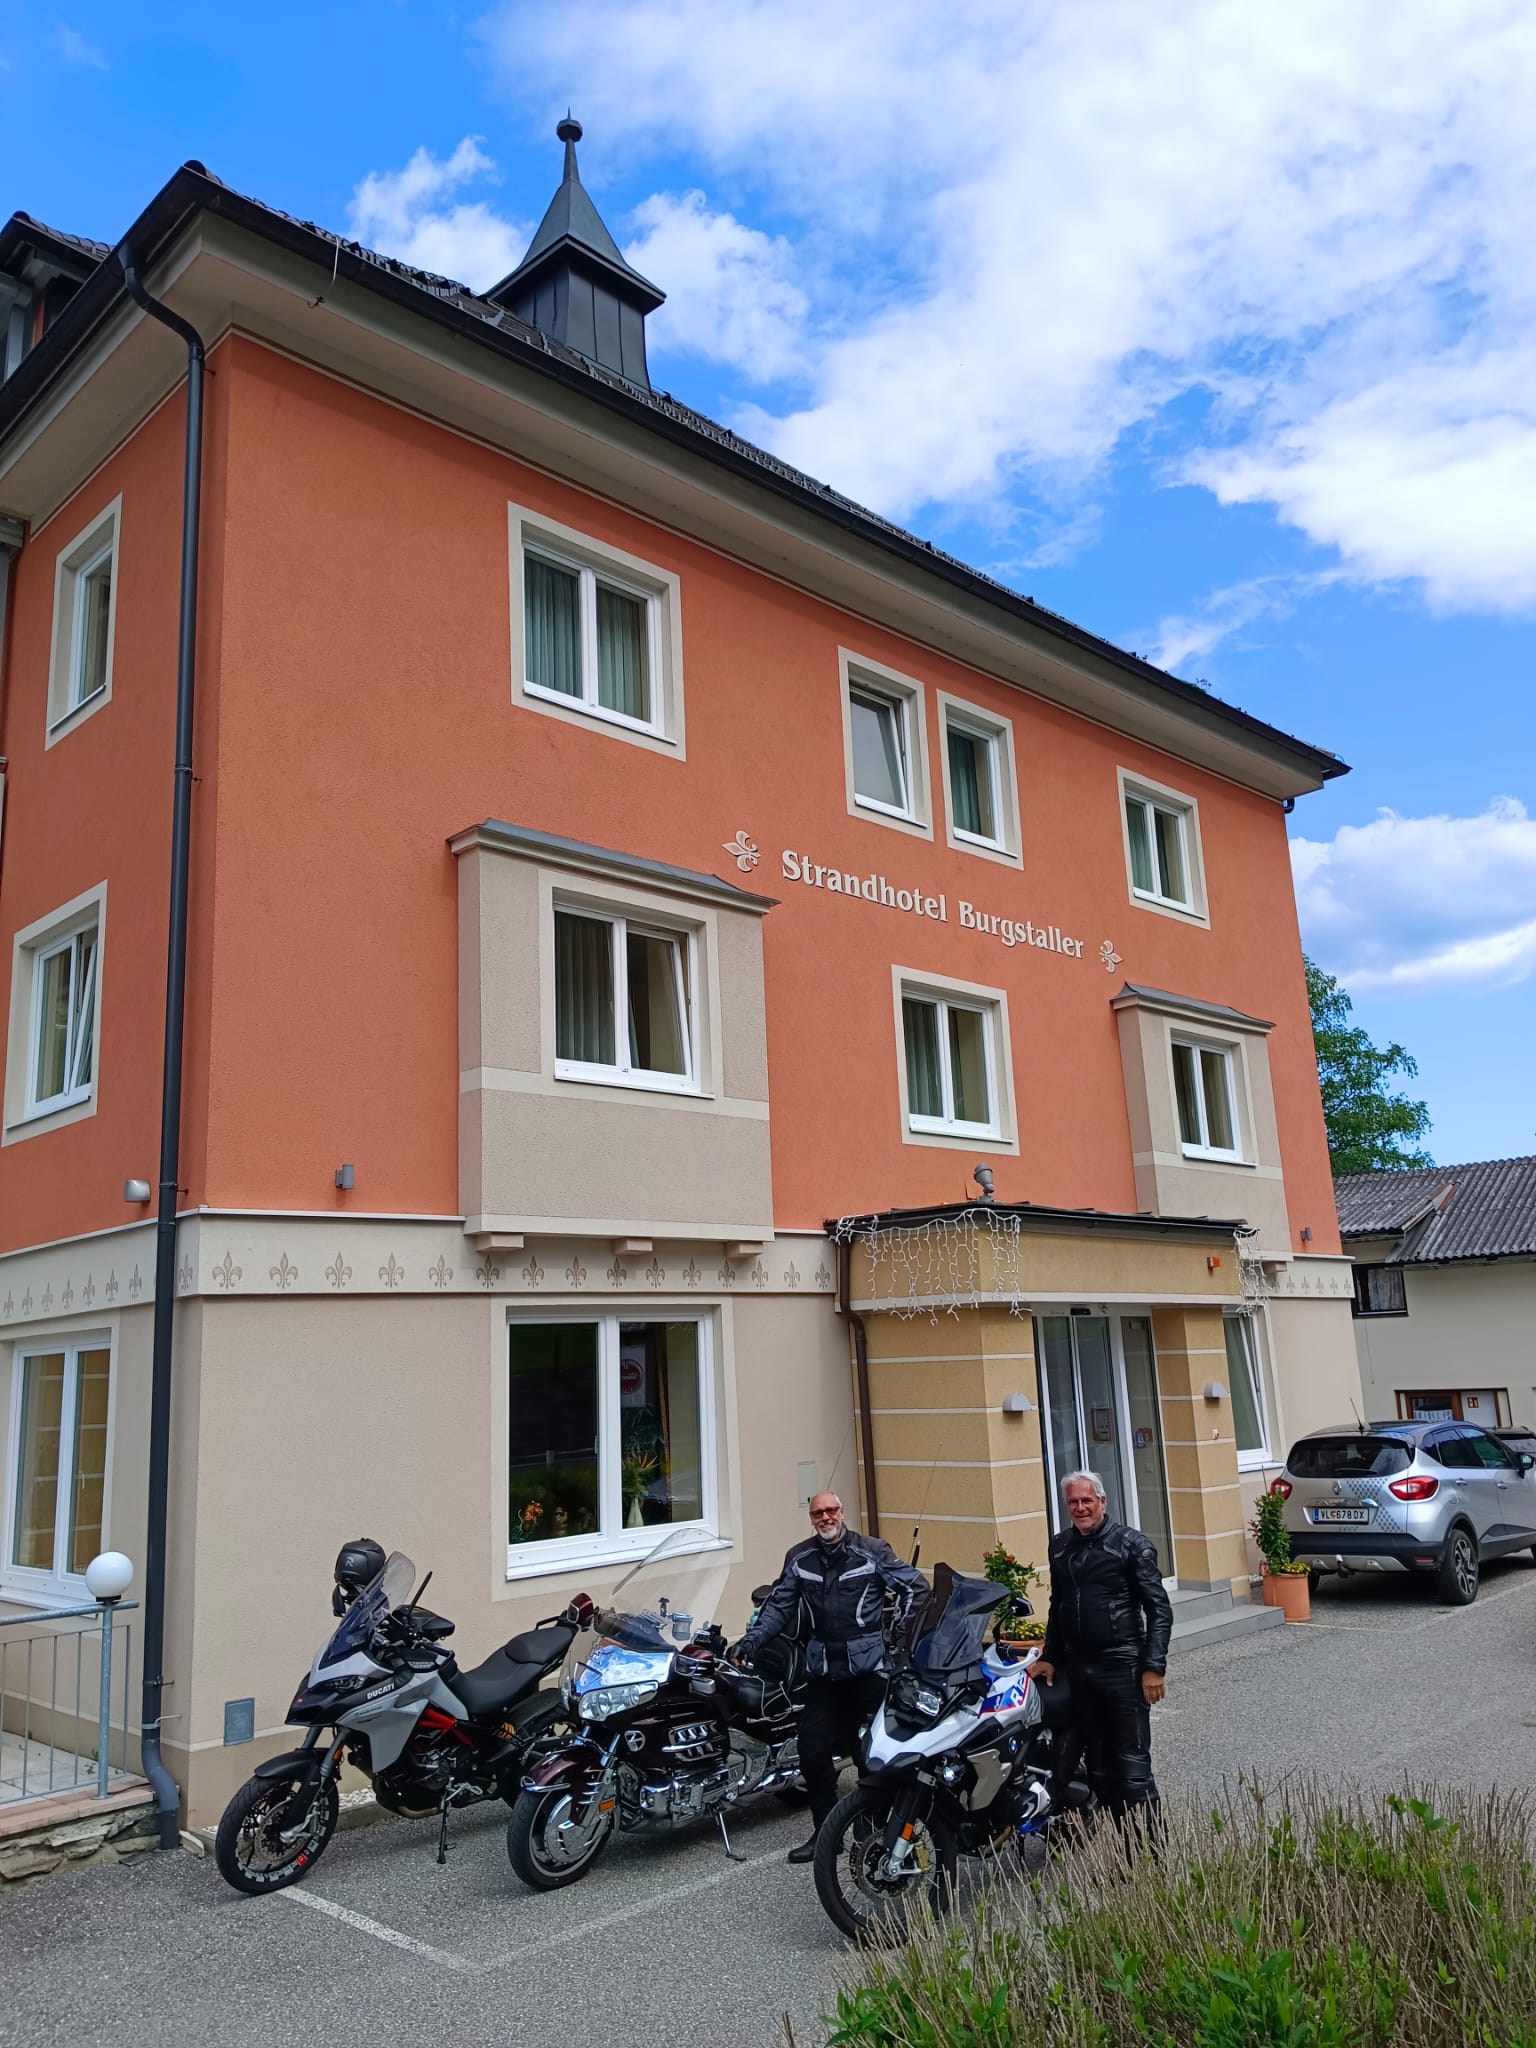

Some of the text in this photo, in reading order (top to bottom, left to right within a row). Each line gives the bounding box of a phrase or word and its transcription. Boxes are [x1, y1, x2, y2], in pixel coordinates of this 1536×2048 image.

[782, 849, 1084, 959] Strandhotel Burgstaller
[367, 1683, 395, 1700] DUCATI
